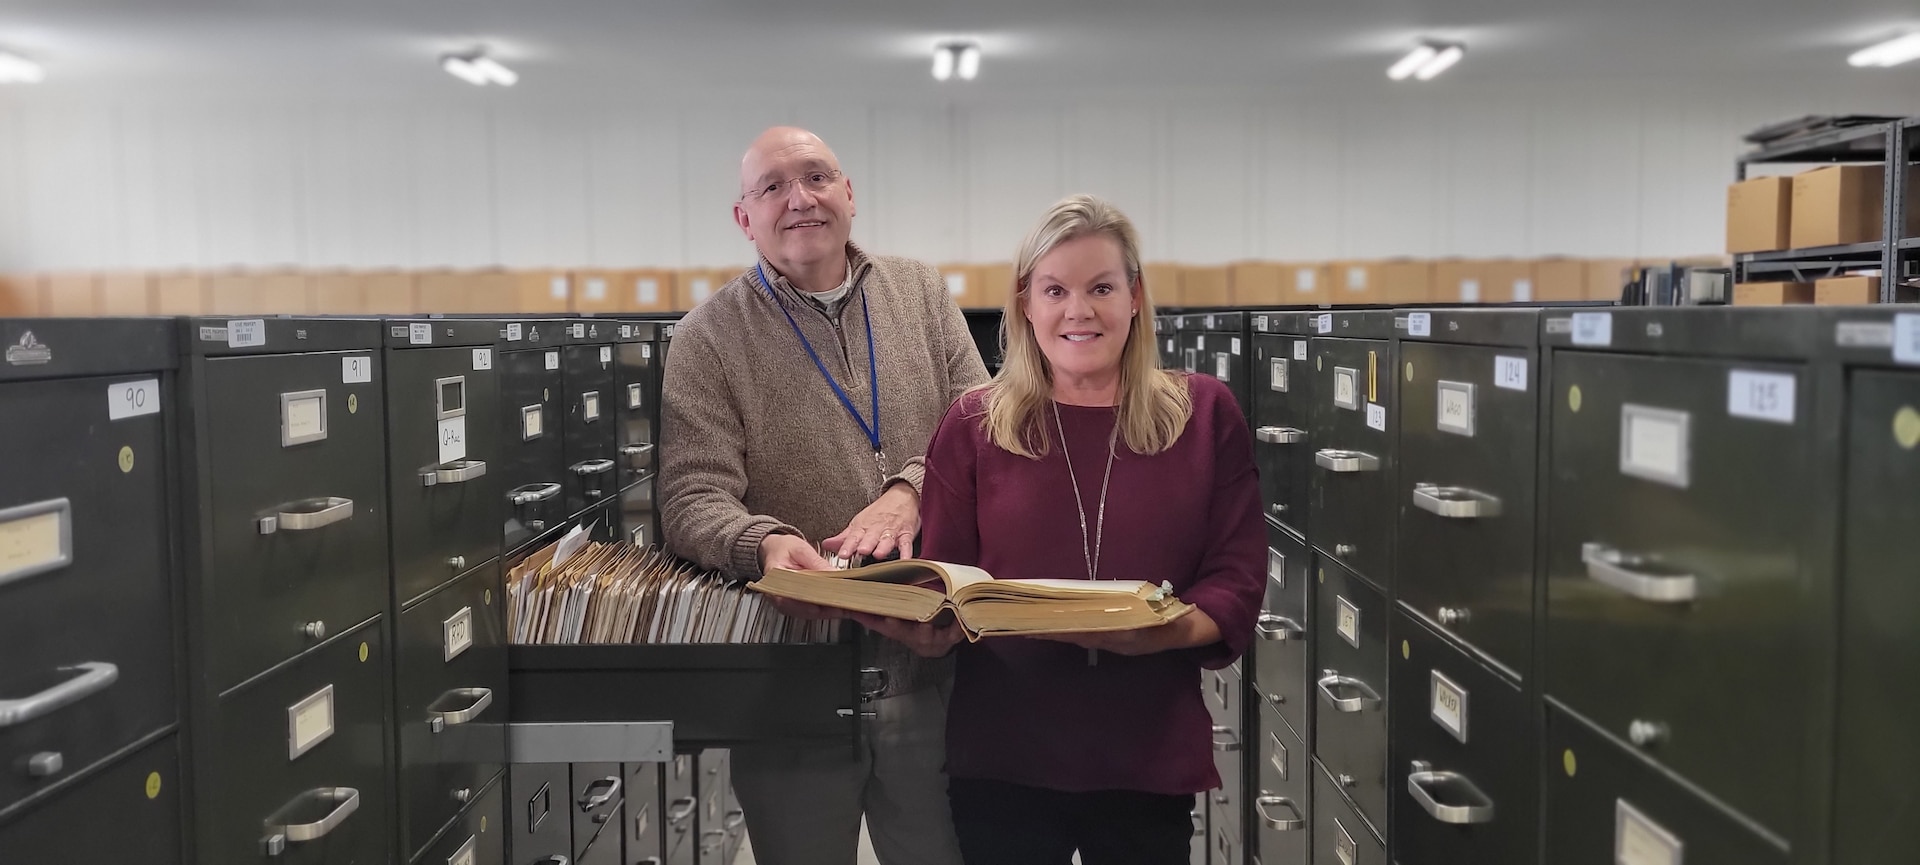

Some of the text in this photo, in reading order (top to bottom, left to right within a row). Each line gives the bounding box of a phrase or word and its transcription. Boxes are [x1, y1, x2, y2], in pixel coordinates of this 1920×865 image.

[352, 359, 363, 377] 91
[479, 352, 488, 367] 92
[1504, 360, 1520, 385] 124
[126, 386, 146, 411] 90
